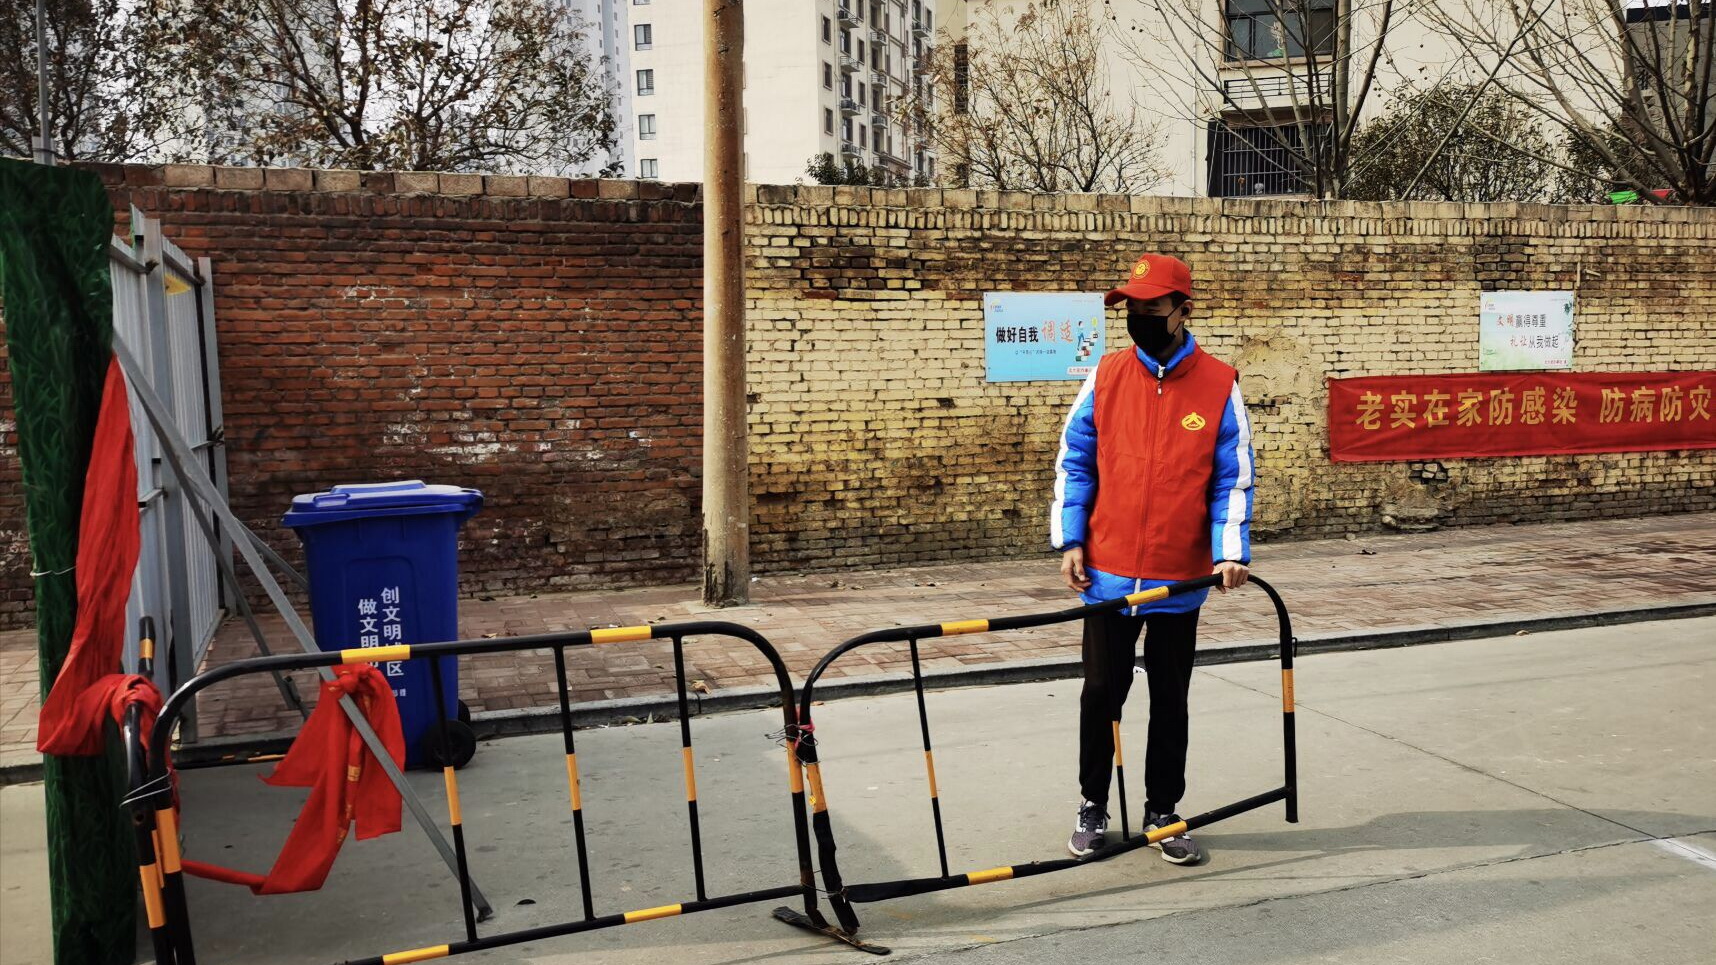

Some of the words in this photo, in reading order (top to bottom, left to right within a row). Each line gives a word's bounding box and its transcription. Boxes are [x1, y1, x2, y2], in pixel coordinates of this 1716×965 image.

[1497, 313, 1546, 328] 文明赢得尊重
[1355, 386, 1578, 429] 老实在家防感染
[1599, 384, 1712, 424] 防病防灾
[381, 586, 404, 676] 创文明区
